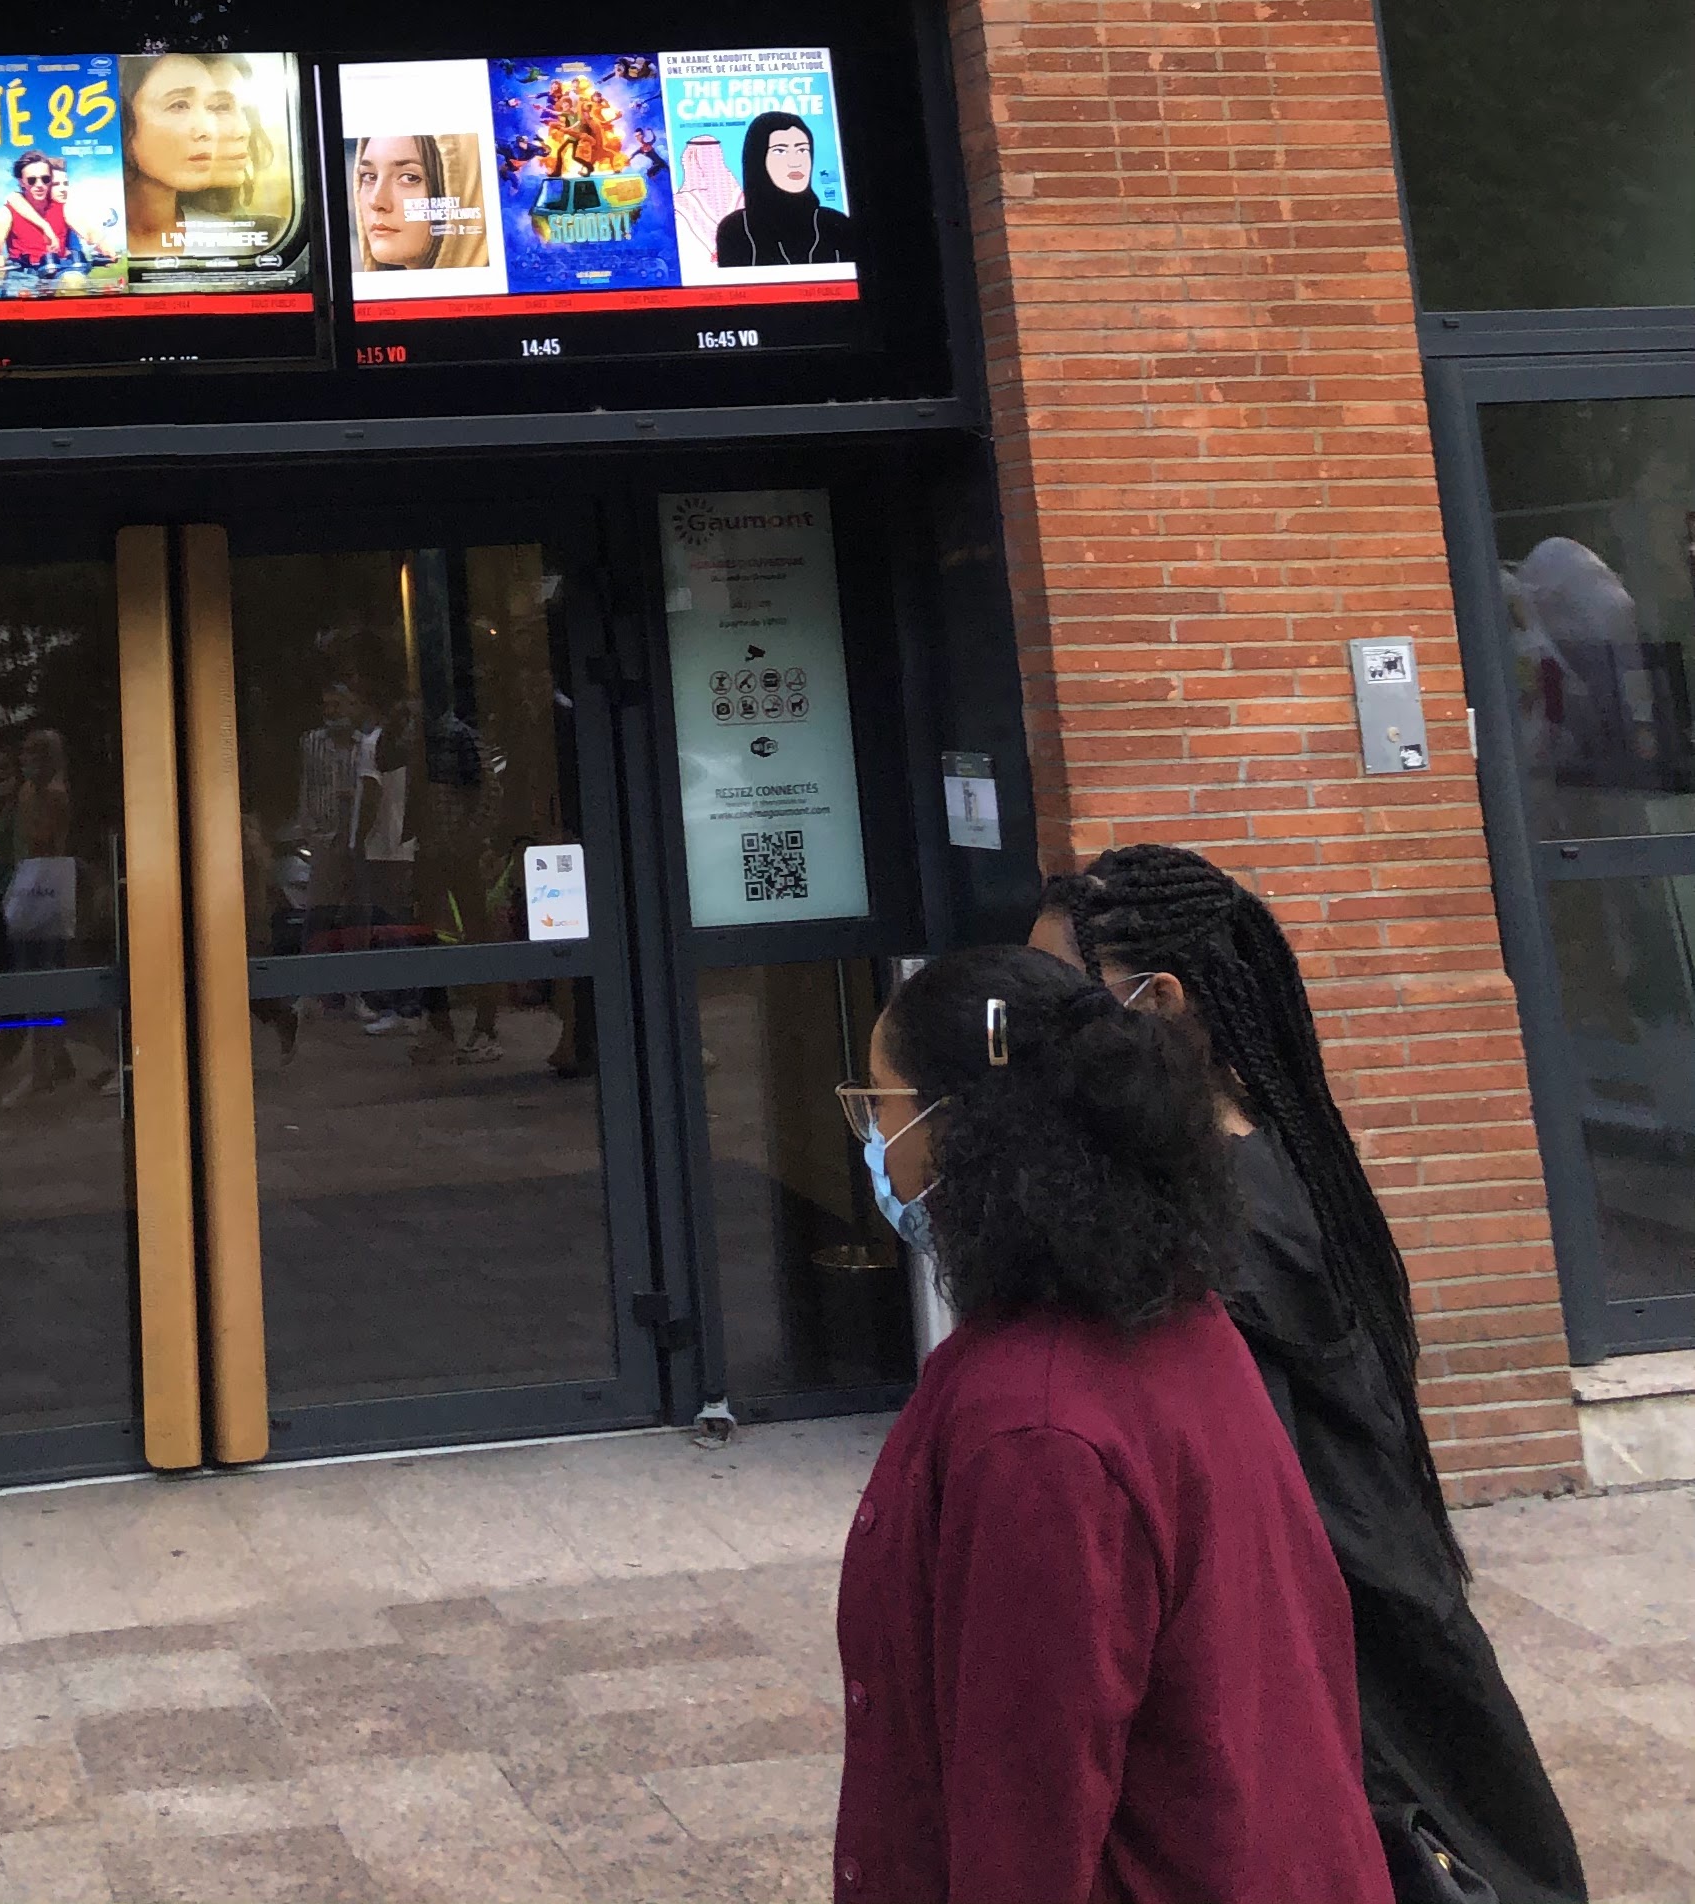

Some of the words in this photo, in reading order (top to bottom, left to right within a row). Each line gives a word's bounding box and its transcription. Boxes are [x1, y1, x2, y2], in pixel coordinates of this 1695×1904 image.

[683, 79, 722, 100] THE
[728, 76, 814, 99] PERFECT
[47, 79, 118, 140] 85
[675, 94, 825, 121] CANDIDATE
[520, 337, 562, 357] 14:45
[696, 330, 737, 349] 16:45
[737, 328, 759, 347] VO
[386, 345, 407, 363] VO
[687, 510, 816, 532] Gaumont
[715, 787, 754, 799] RESTEZ
[755, 782, 819, 797] CONNECTÉS
